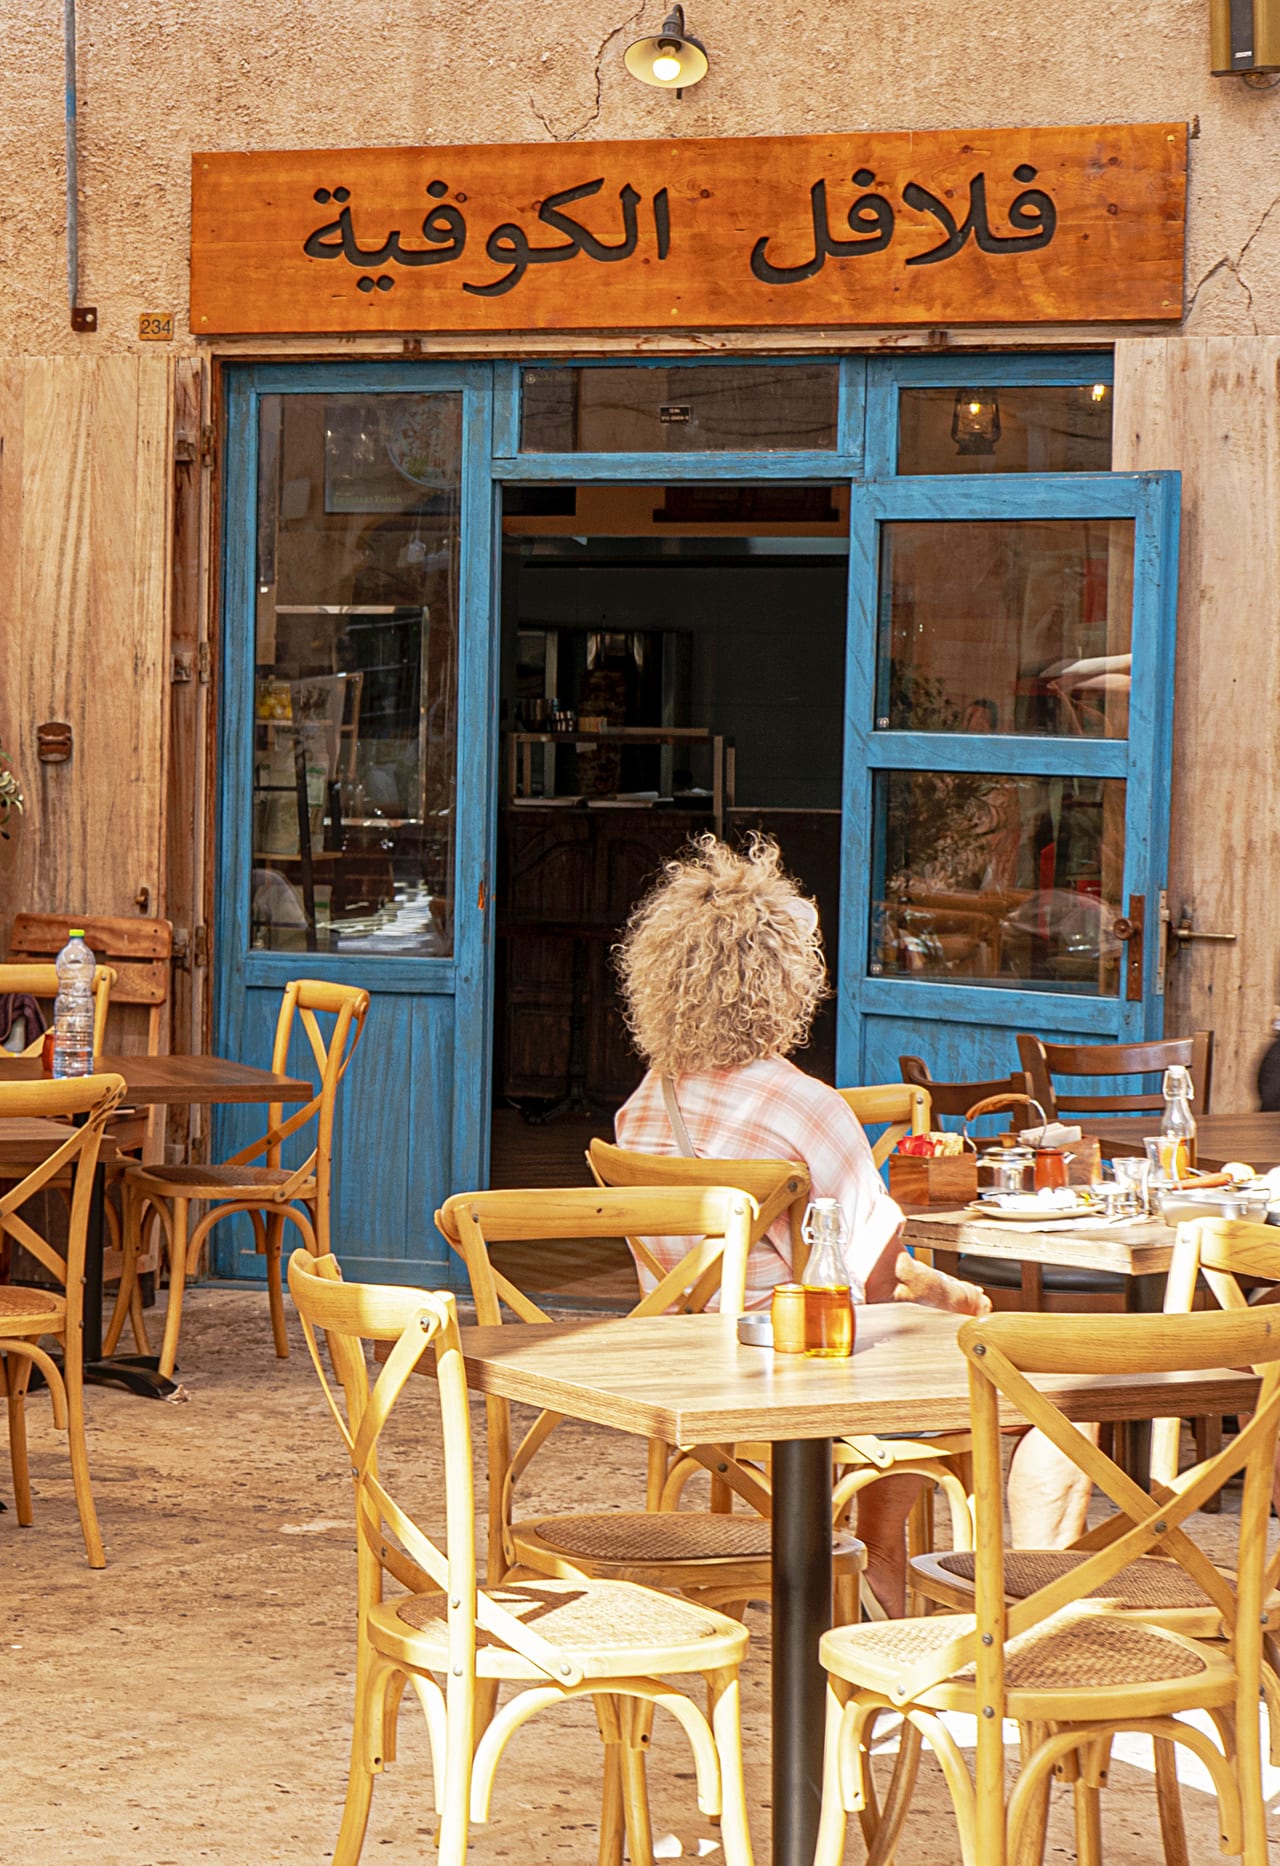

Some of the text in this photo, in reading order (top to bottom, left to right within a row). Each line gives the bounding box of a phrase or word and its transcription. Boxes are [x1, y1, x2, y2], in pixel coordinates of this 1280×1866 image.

[303, 163, 1058, 297] فلافل الكوفية
[140, 319, 171, 335] 234
